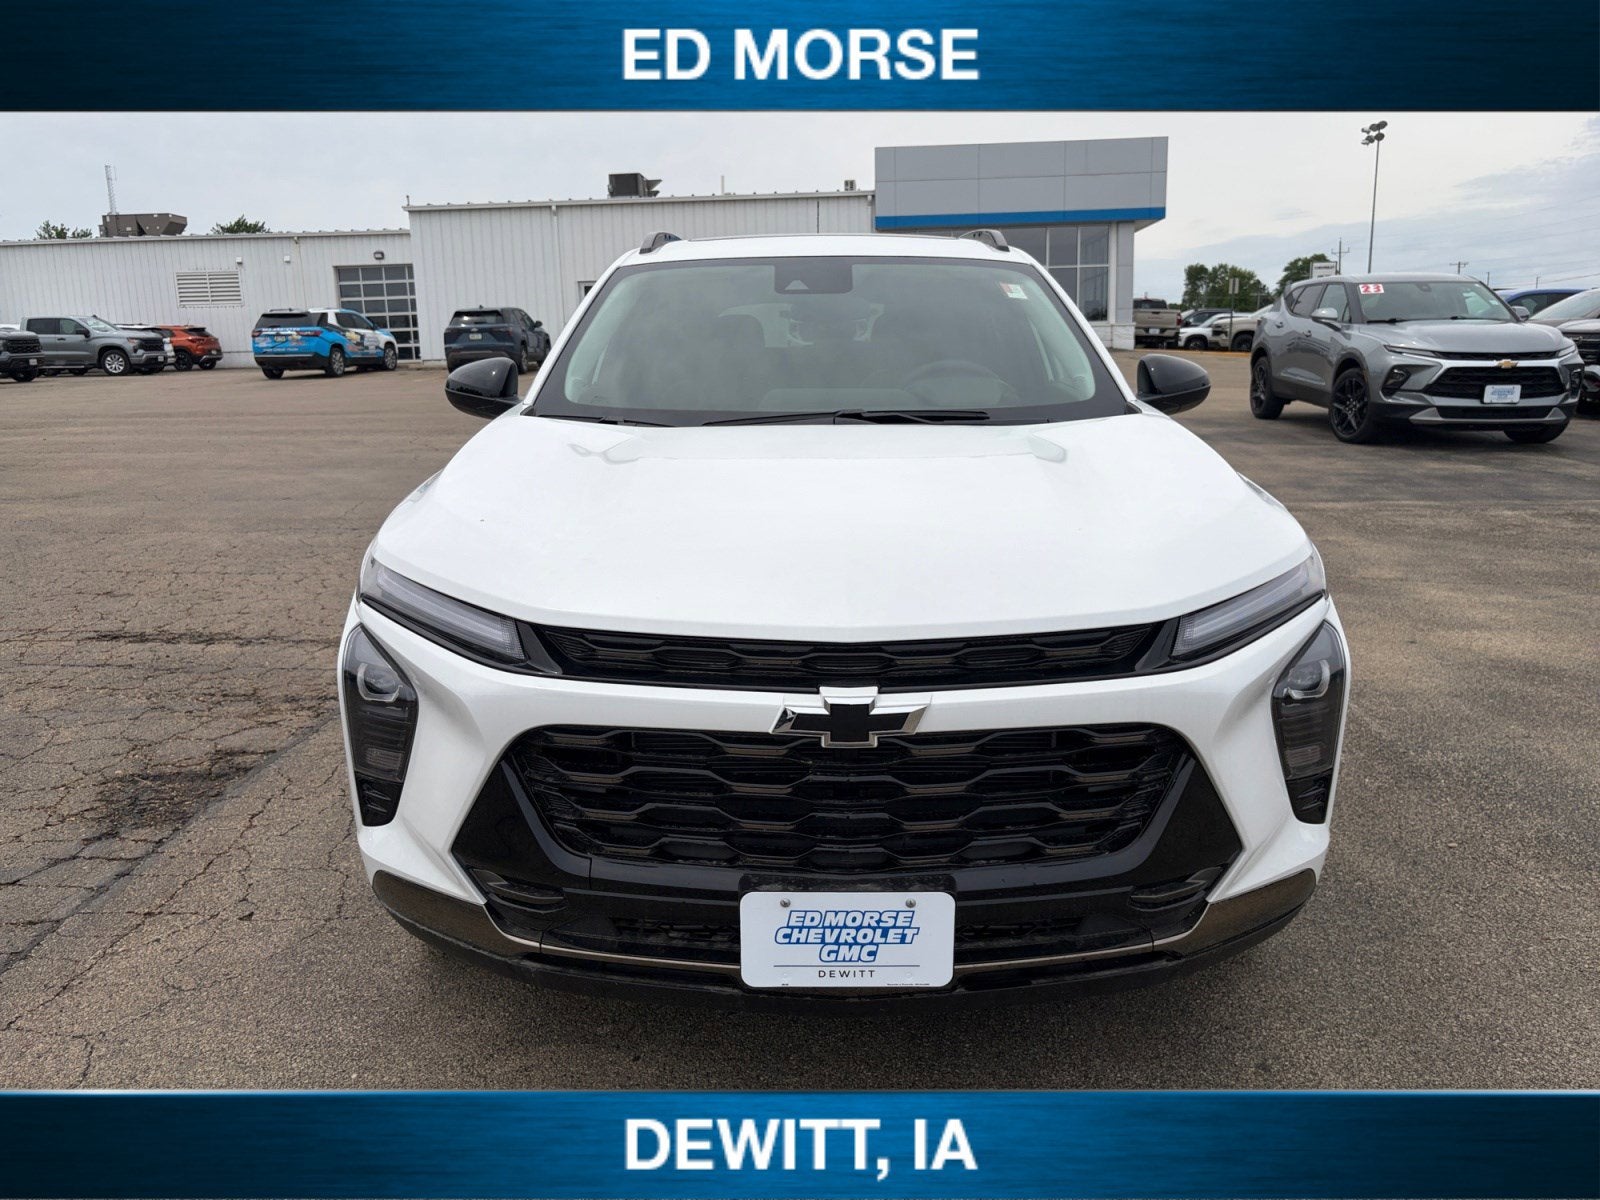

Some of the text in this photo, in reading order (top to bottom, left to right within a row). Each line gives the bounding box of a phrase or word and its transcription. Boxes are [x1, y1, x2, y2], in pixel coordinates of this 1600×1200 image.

[1361, 284, 1381, 293] 23
[787, 910, 915, 927] ED MORSE
[775, 927, 920, 944] CHEVROLET
[819, 944, 879, 962] GMC
[818, 969, 876, 978] DEWITT
